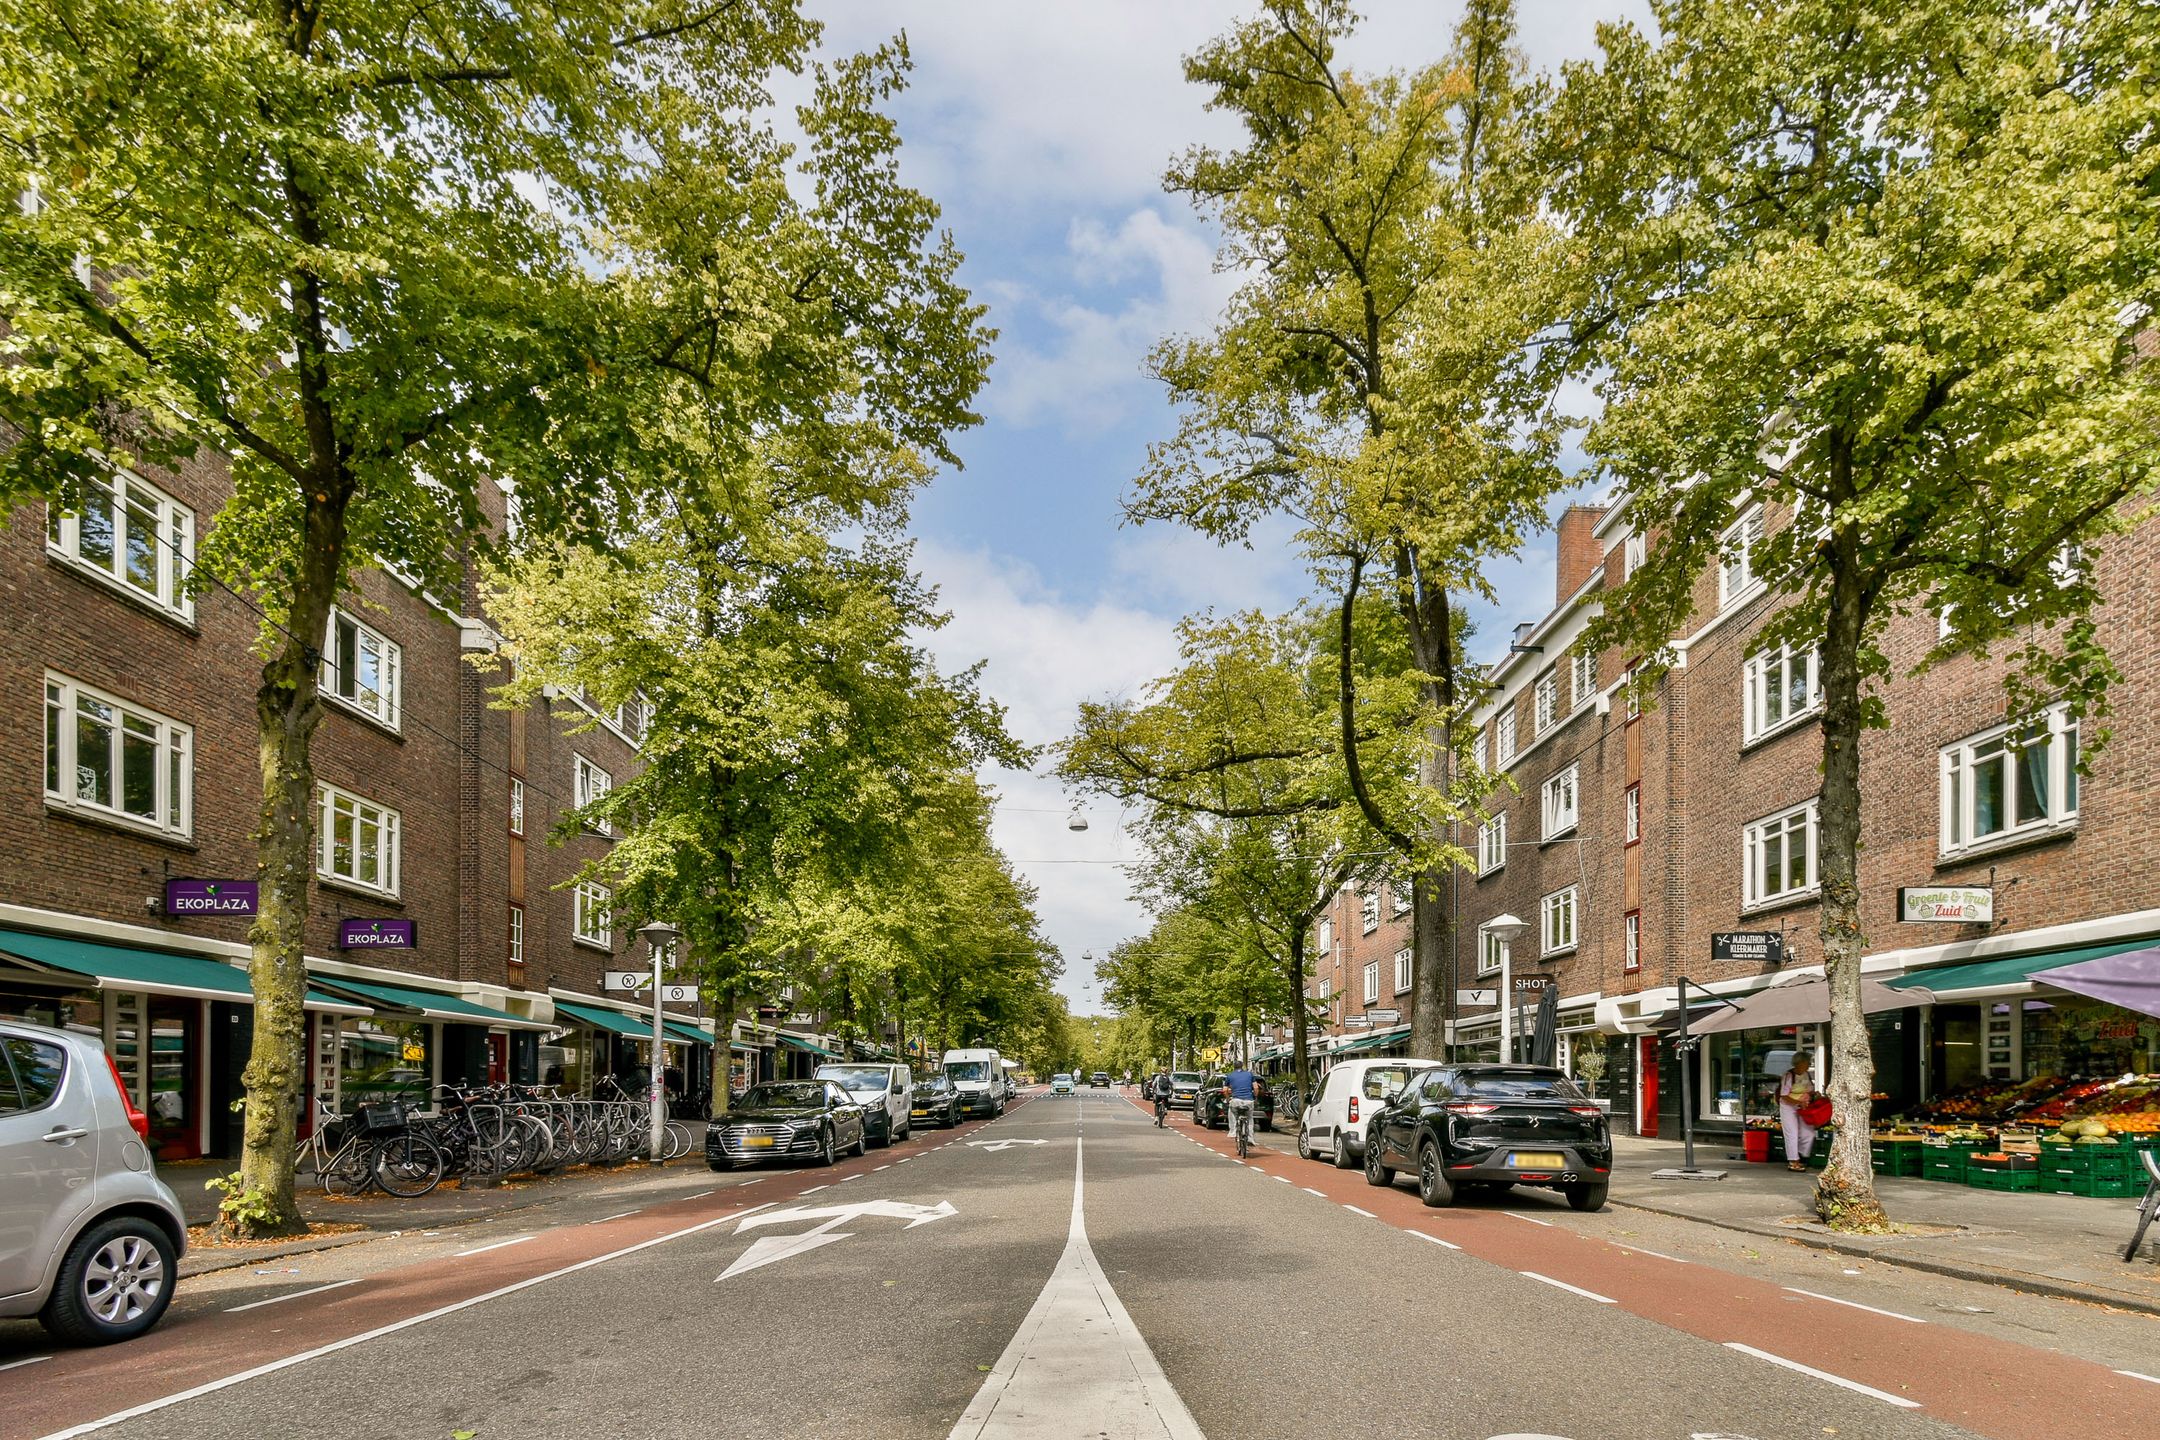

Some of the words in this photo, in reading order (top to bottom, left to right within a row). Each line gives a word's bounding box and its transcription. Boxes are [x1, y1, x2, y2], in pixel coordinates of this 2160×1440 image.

[1950, 890, 1961, 903] &
[1963, 891, 1990, 907] Fruit
[176, 898, 250, 910] EKOPLAZA
[1935, 904, 1962, 917] Zuid
[348, 934, 405, 944] EKOPLAZA
[1732, 935, 1766, 944] MARATHON
[1730, 944, 1768, 953] KLEERMAKER
[1515, 979, 1548, 989] SHOT
[1206, 1051, 1212, 1059] L
